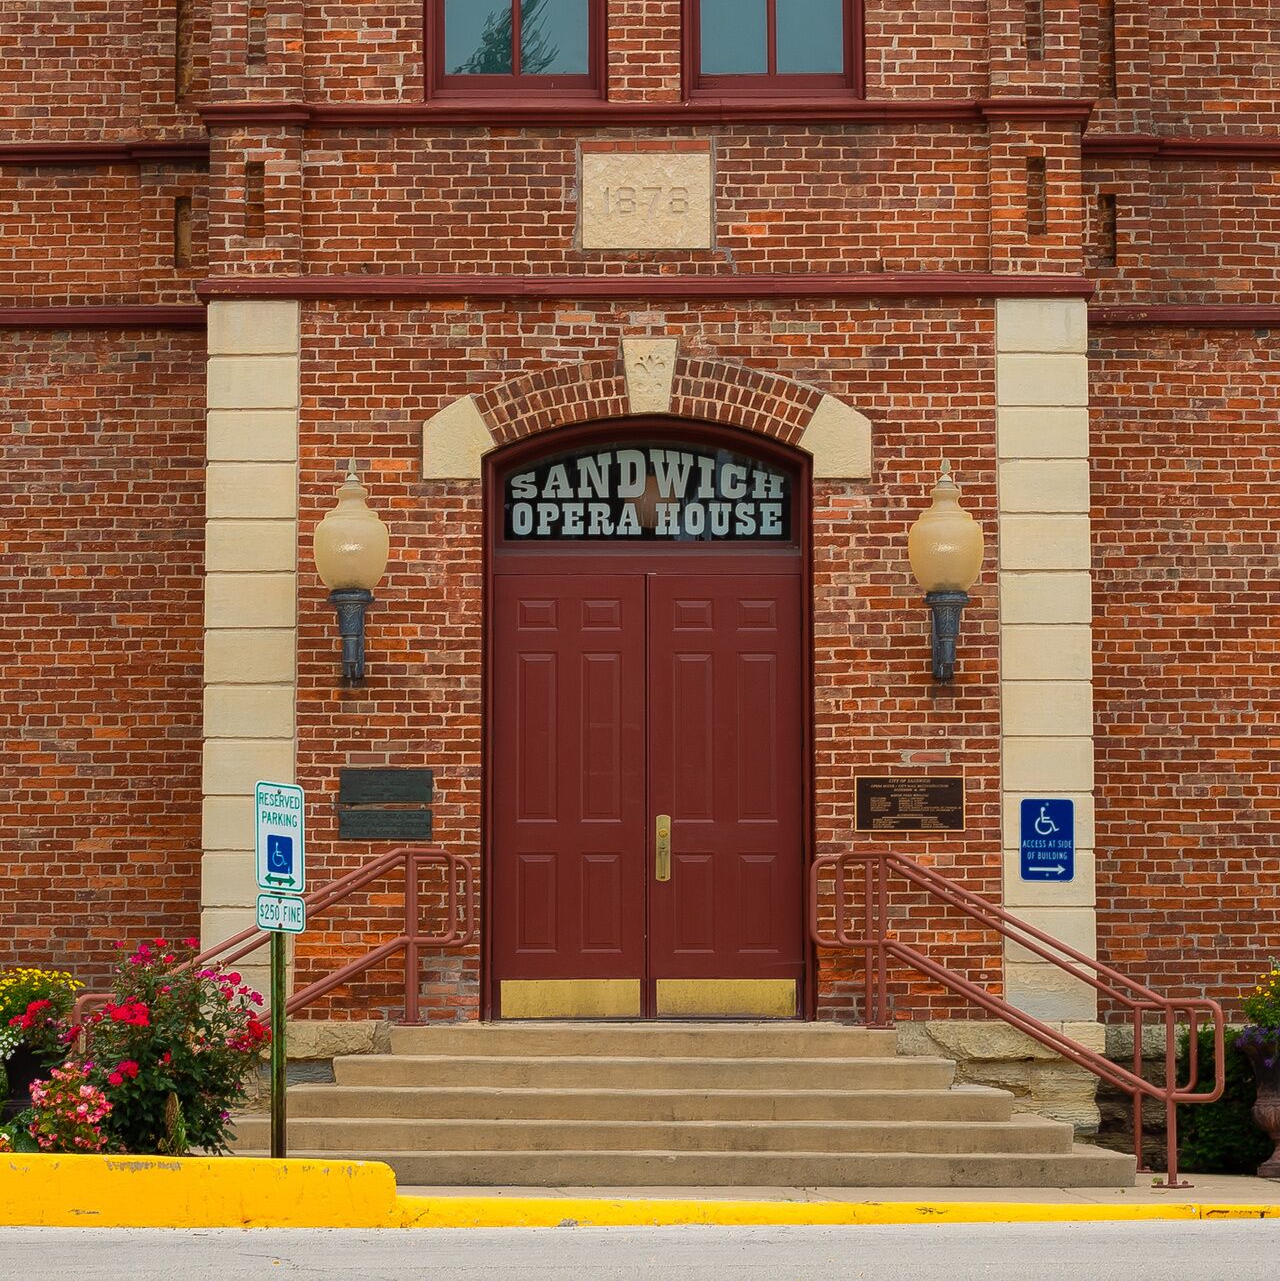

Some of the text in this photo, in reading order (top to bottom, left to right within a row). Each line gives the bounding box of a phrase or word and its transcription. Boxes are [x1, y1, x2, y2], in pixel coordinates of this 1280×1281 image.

[603, 186, 689, 219] 1878
[510, 449, 784, 499] SANDWICH
[512, 502, 783, 535] OPERA HOUSE
[259, 792, 300, 809] RESERVED
[261, 811, 298, 828] PARKING
[1022, 839, 1072, 848] ACCESS AT SIDE
[1027, 851, 1068, 860] OF BUILDING
[259, 904, 302, 923] $250 FINE
